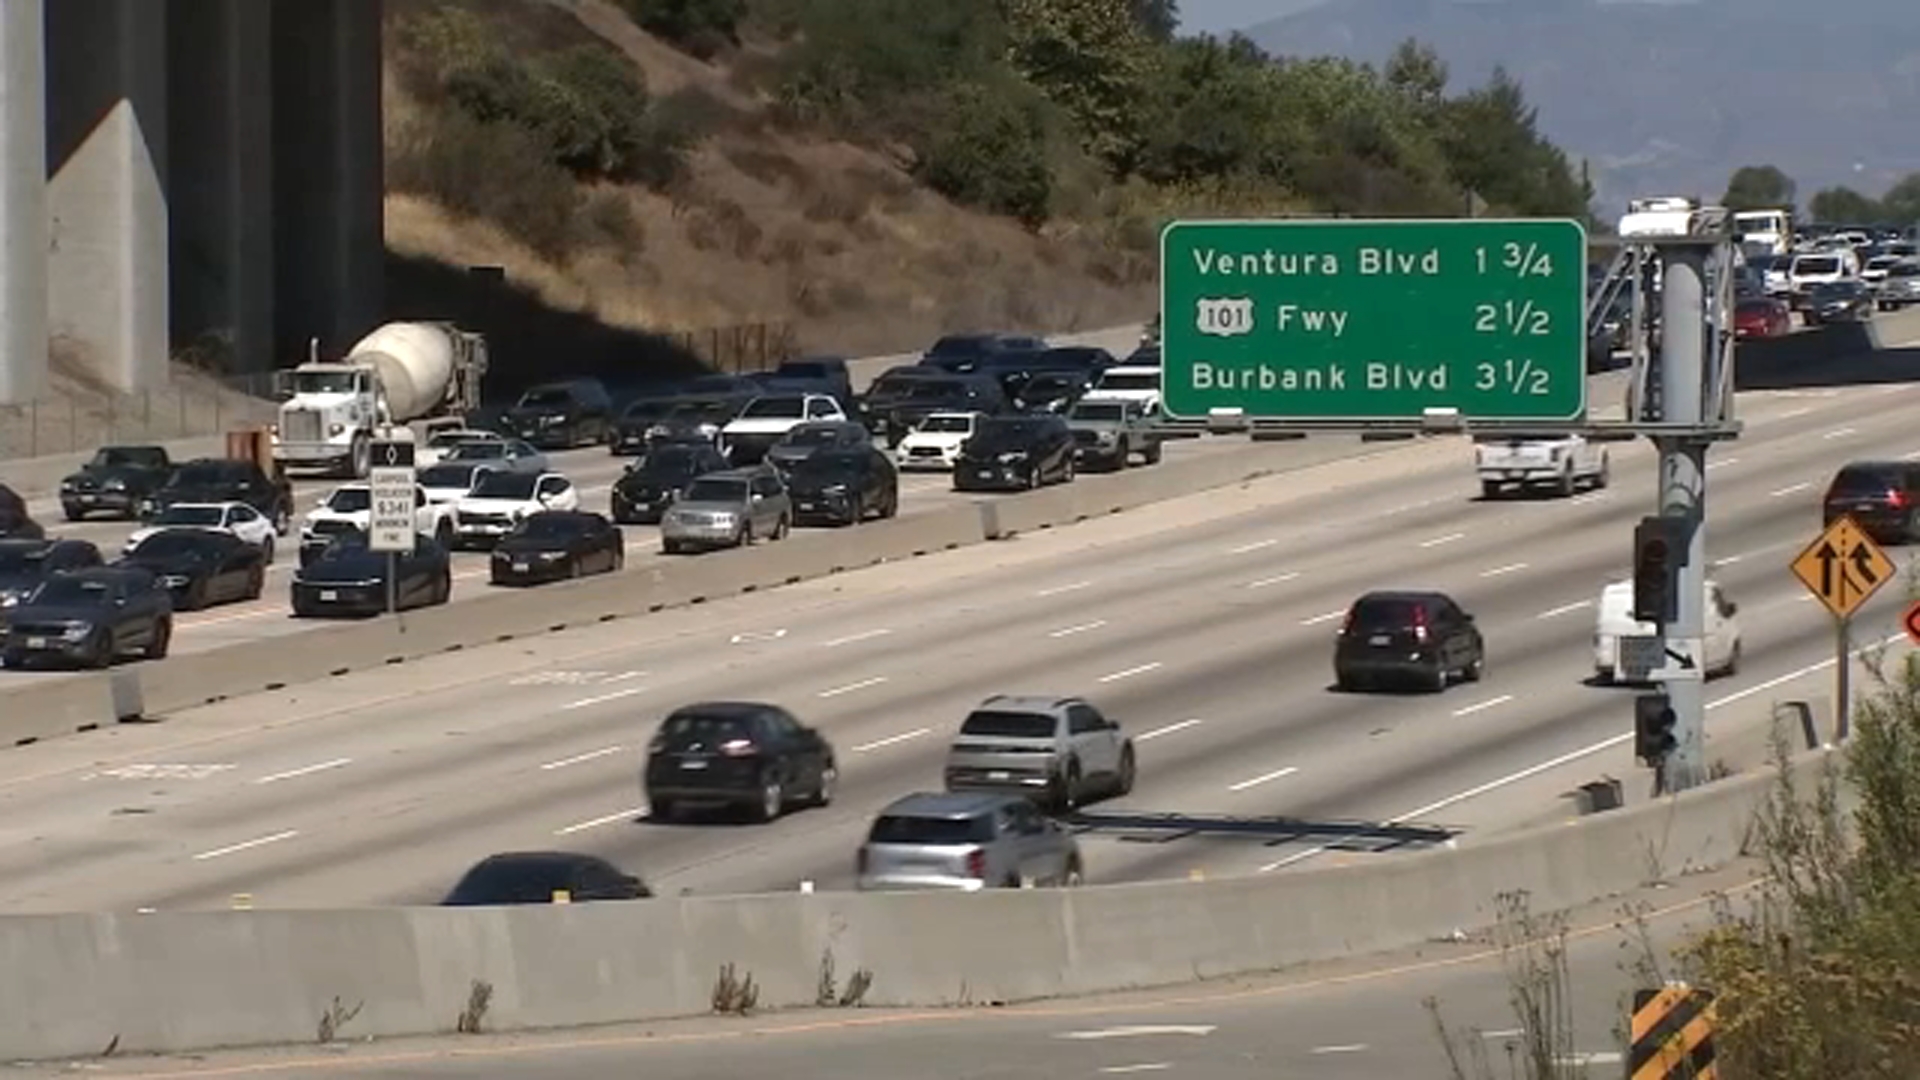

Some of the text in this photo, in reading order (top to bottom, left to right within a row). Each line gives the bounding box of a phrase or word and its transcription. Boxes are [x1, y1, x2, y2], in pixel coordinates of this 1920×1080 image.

[1193, 242, 1552, 277] Ventura Blvd 1 3/4
[1206, 306, 1245, 329] 101
[1278, 305, 1348, 336] Fwy
[1192, 363, 1346, 390] Burbank
[1367, 363, 1447, 390] Blvd
[378, 500, 409, 517] $341
